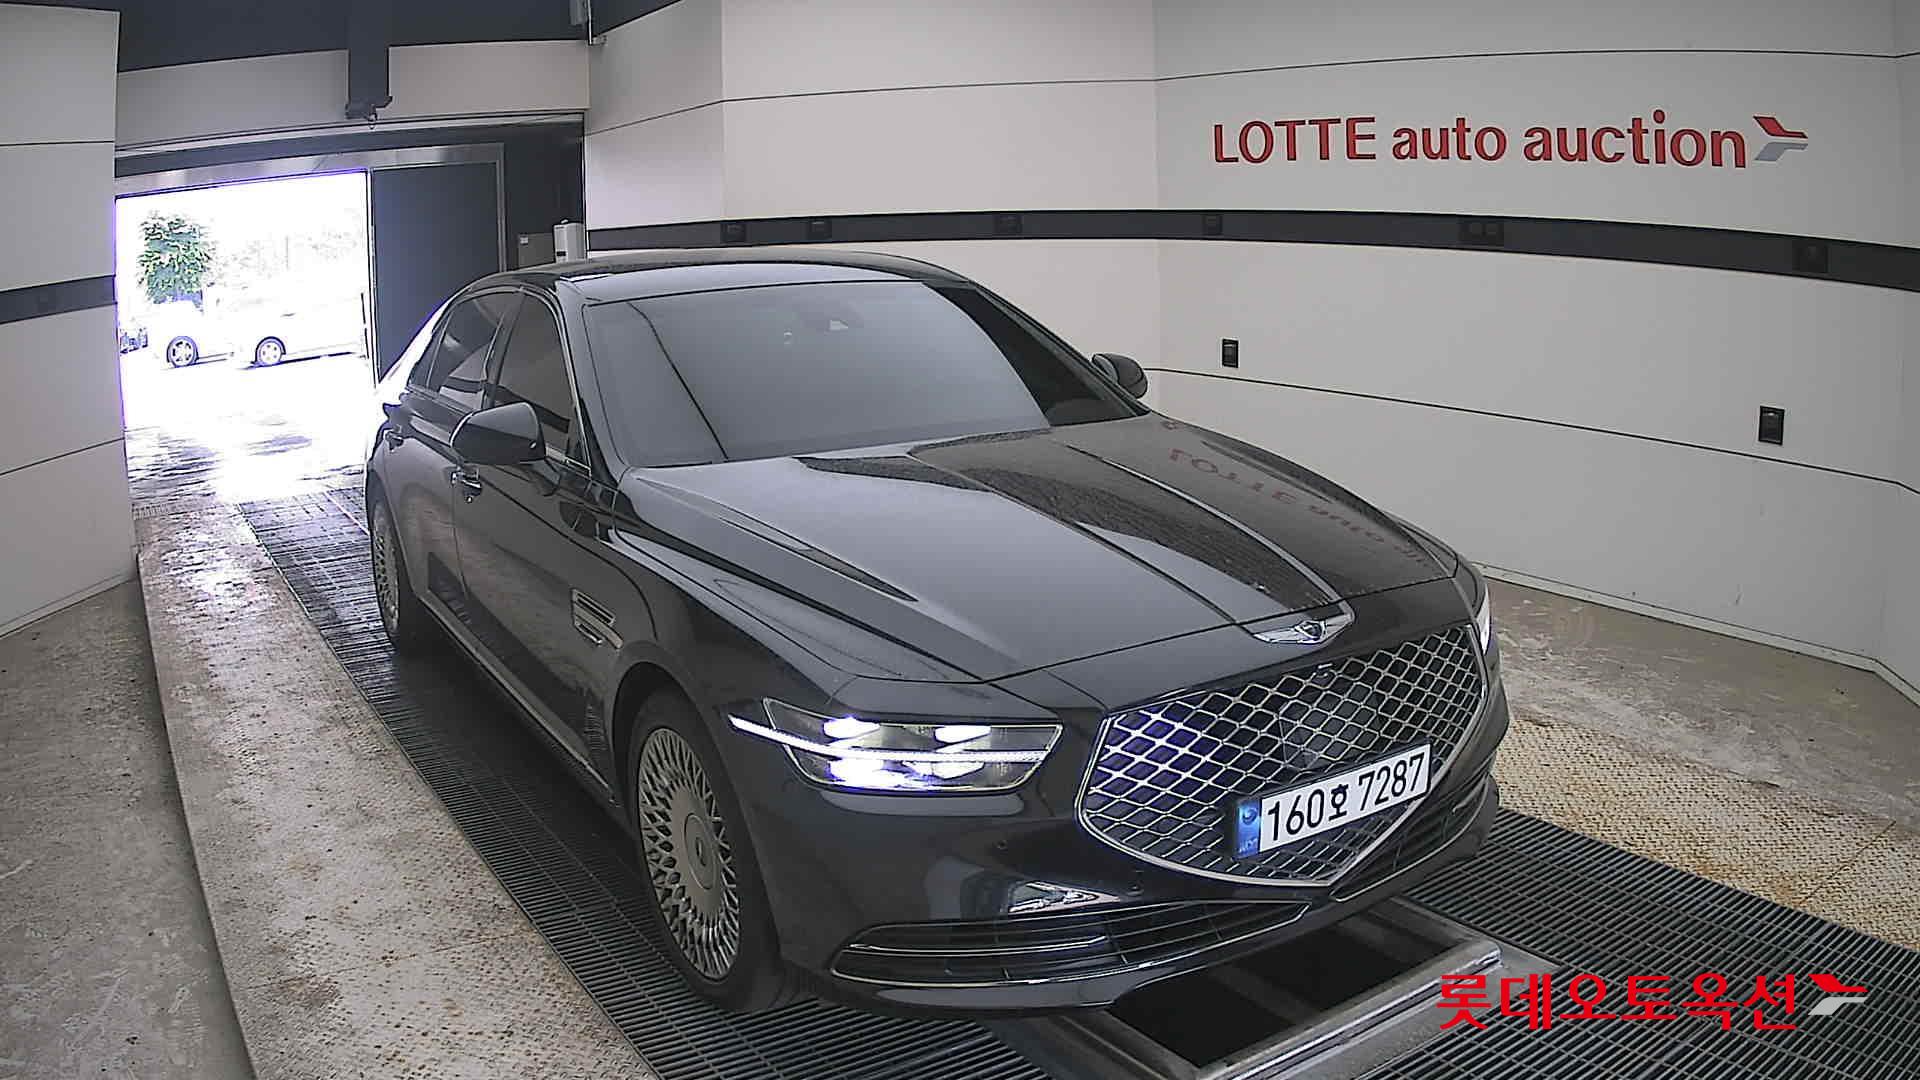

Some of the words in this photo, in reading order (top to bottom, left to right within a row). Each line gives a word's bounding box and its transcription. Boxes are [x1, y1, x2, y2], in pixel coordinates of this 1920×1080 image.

[1213, 116, 1377, 164] LOTTE
[1391, 117, 1507, 161] auto
[1523, 109, 1747, 169] auction
[1267, 783, 1348, 841] 160호
[1358, 752, 1425, 812] 7287
